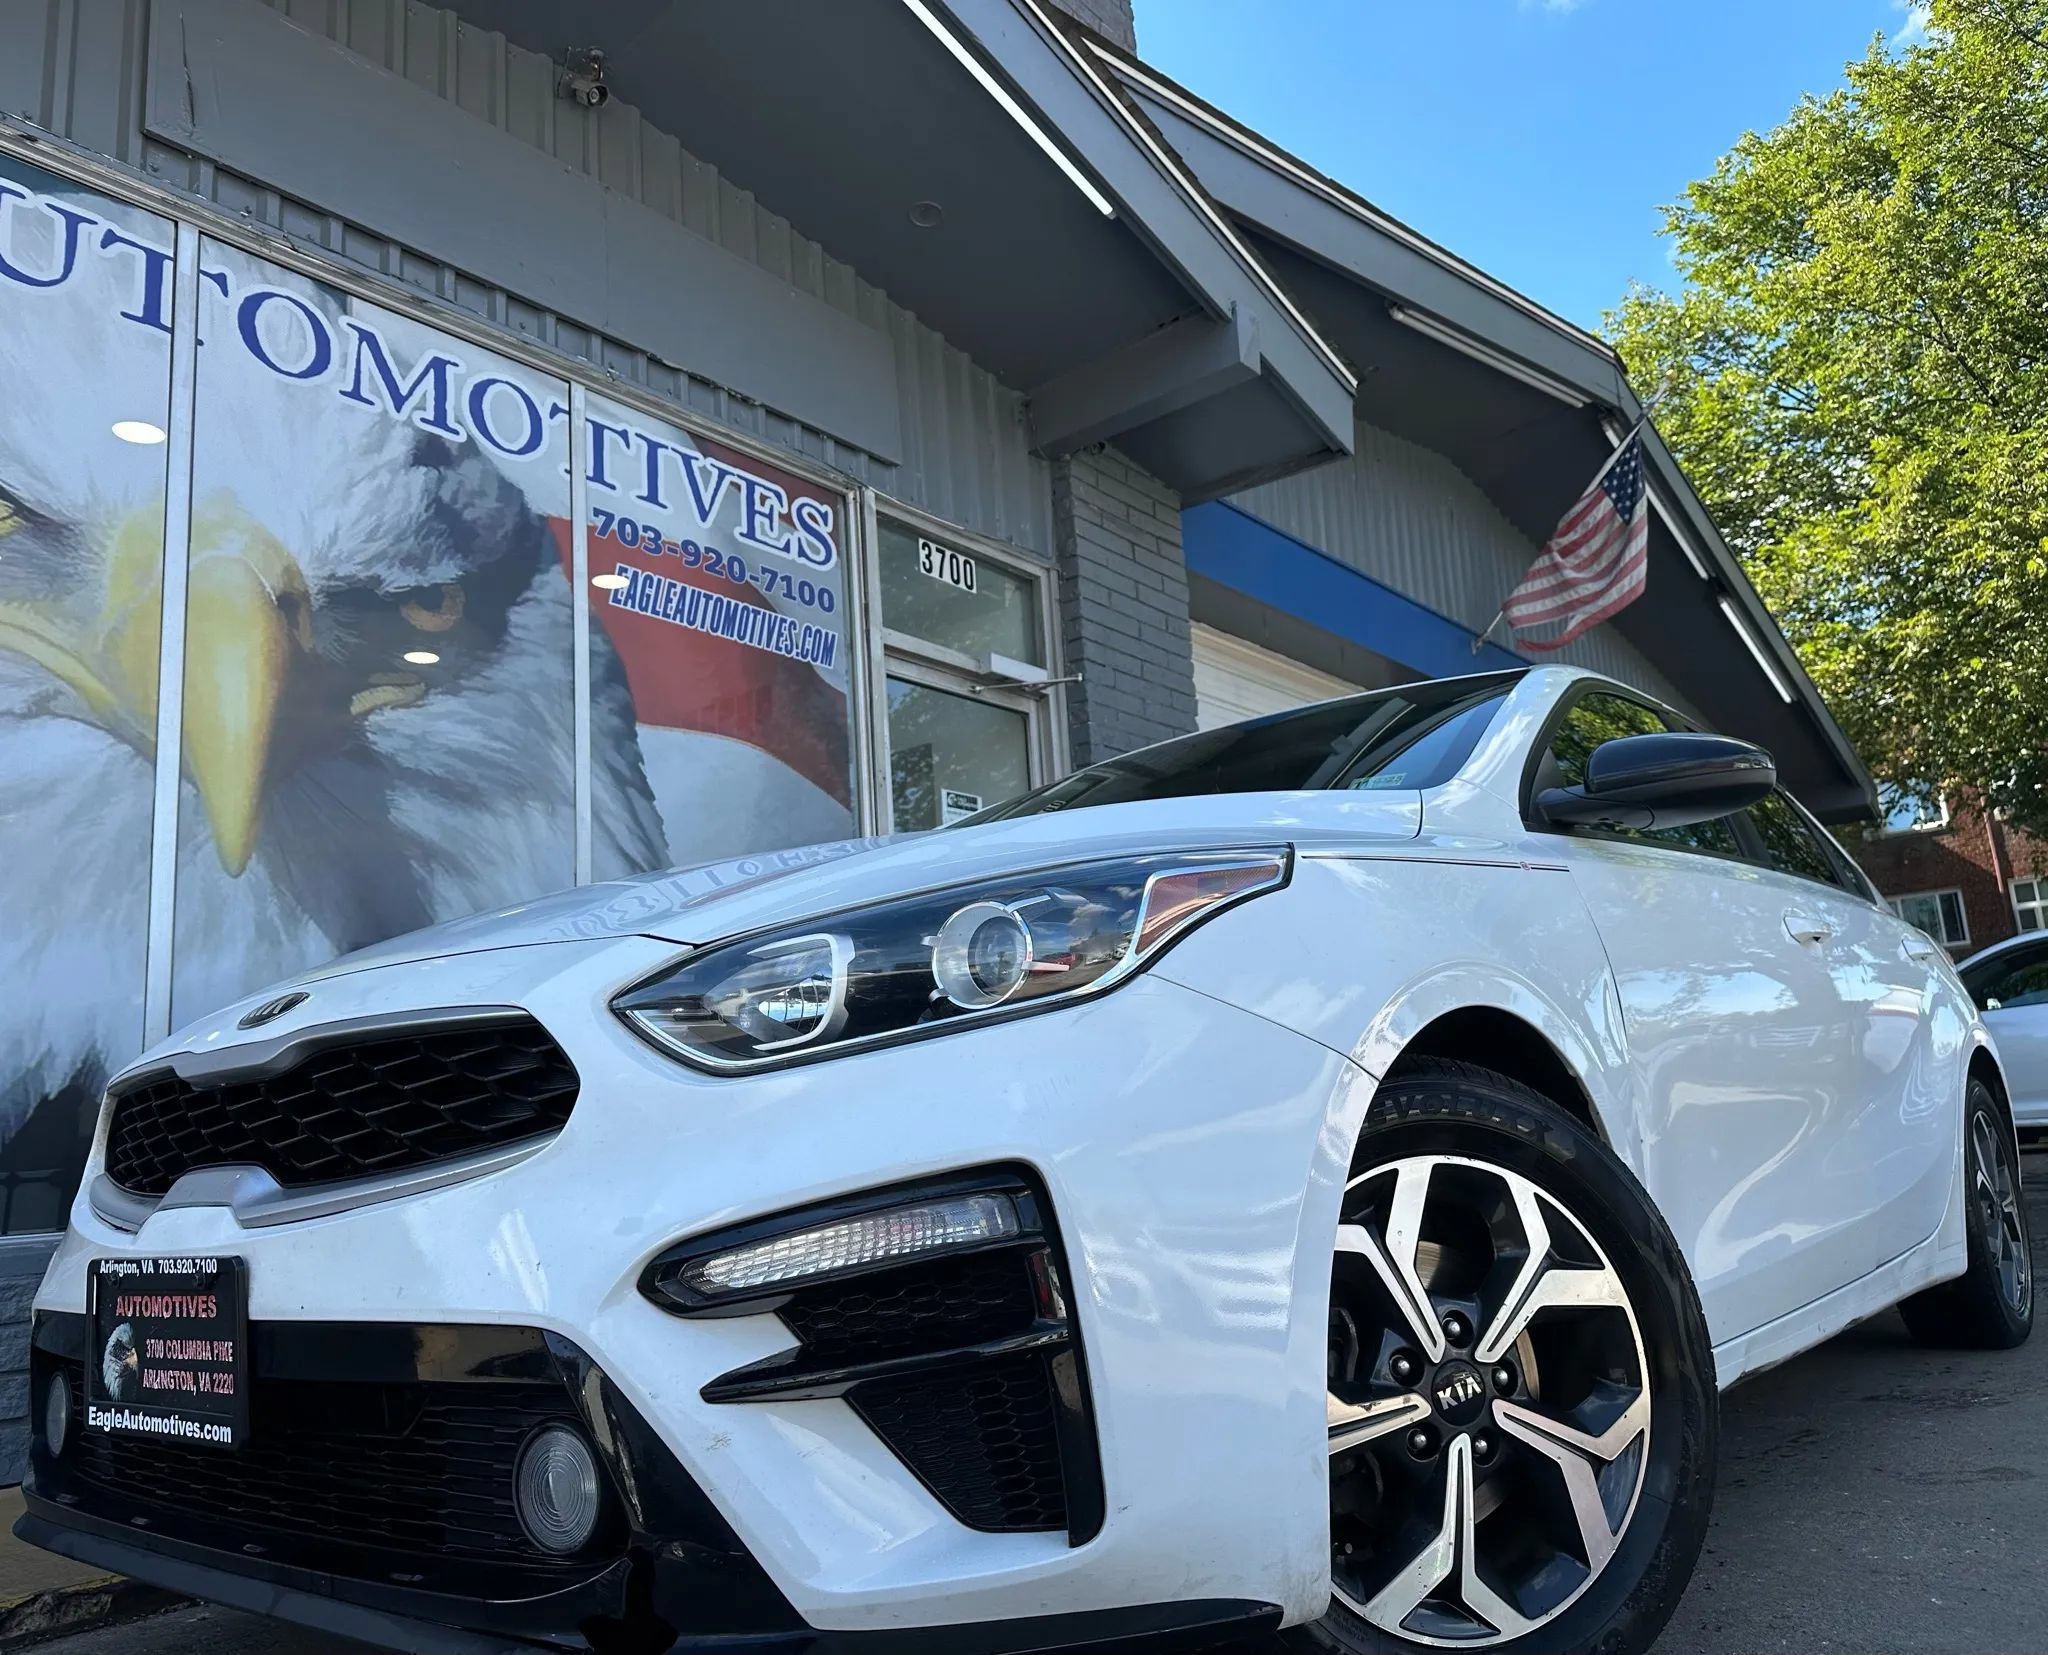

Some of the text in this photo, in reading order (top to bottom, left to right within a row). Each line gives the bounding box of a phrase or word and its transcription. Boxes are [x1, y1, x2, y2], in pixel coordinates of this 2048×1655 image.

[592, 507, 836, 613] 703-920-7100
[921, 542, 975, 591] 3700
[612, 565, 837, 668] EAGLEAUTOMOTIVES.COM
[100, 1258, 217, 1277] Arlington, VA 703.920.7100
[116, 1295, 217, 1318] AUTOMOTIVES
[146, 1339, 233, 1362] 3700 COLUMBIA PIKE
[143, 1369, 197, 1396] ARLINGTON,
[198, 1371, 212, 1392] VA
[1437, 1376, 1482, 1410] KIA
[88, 1406, 232, 1443] EagleAutomotives.com
